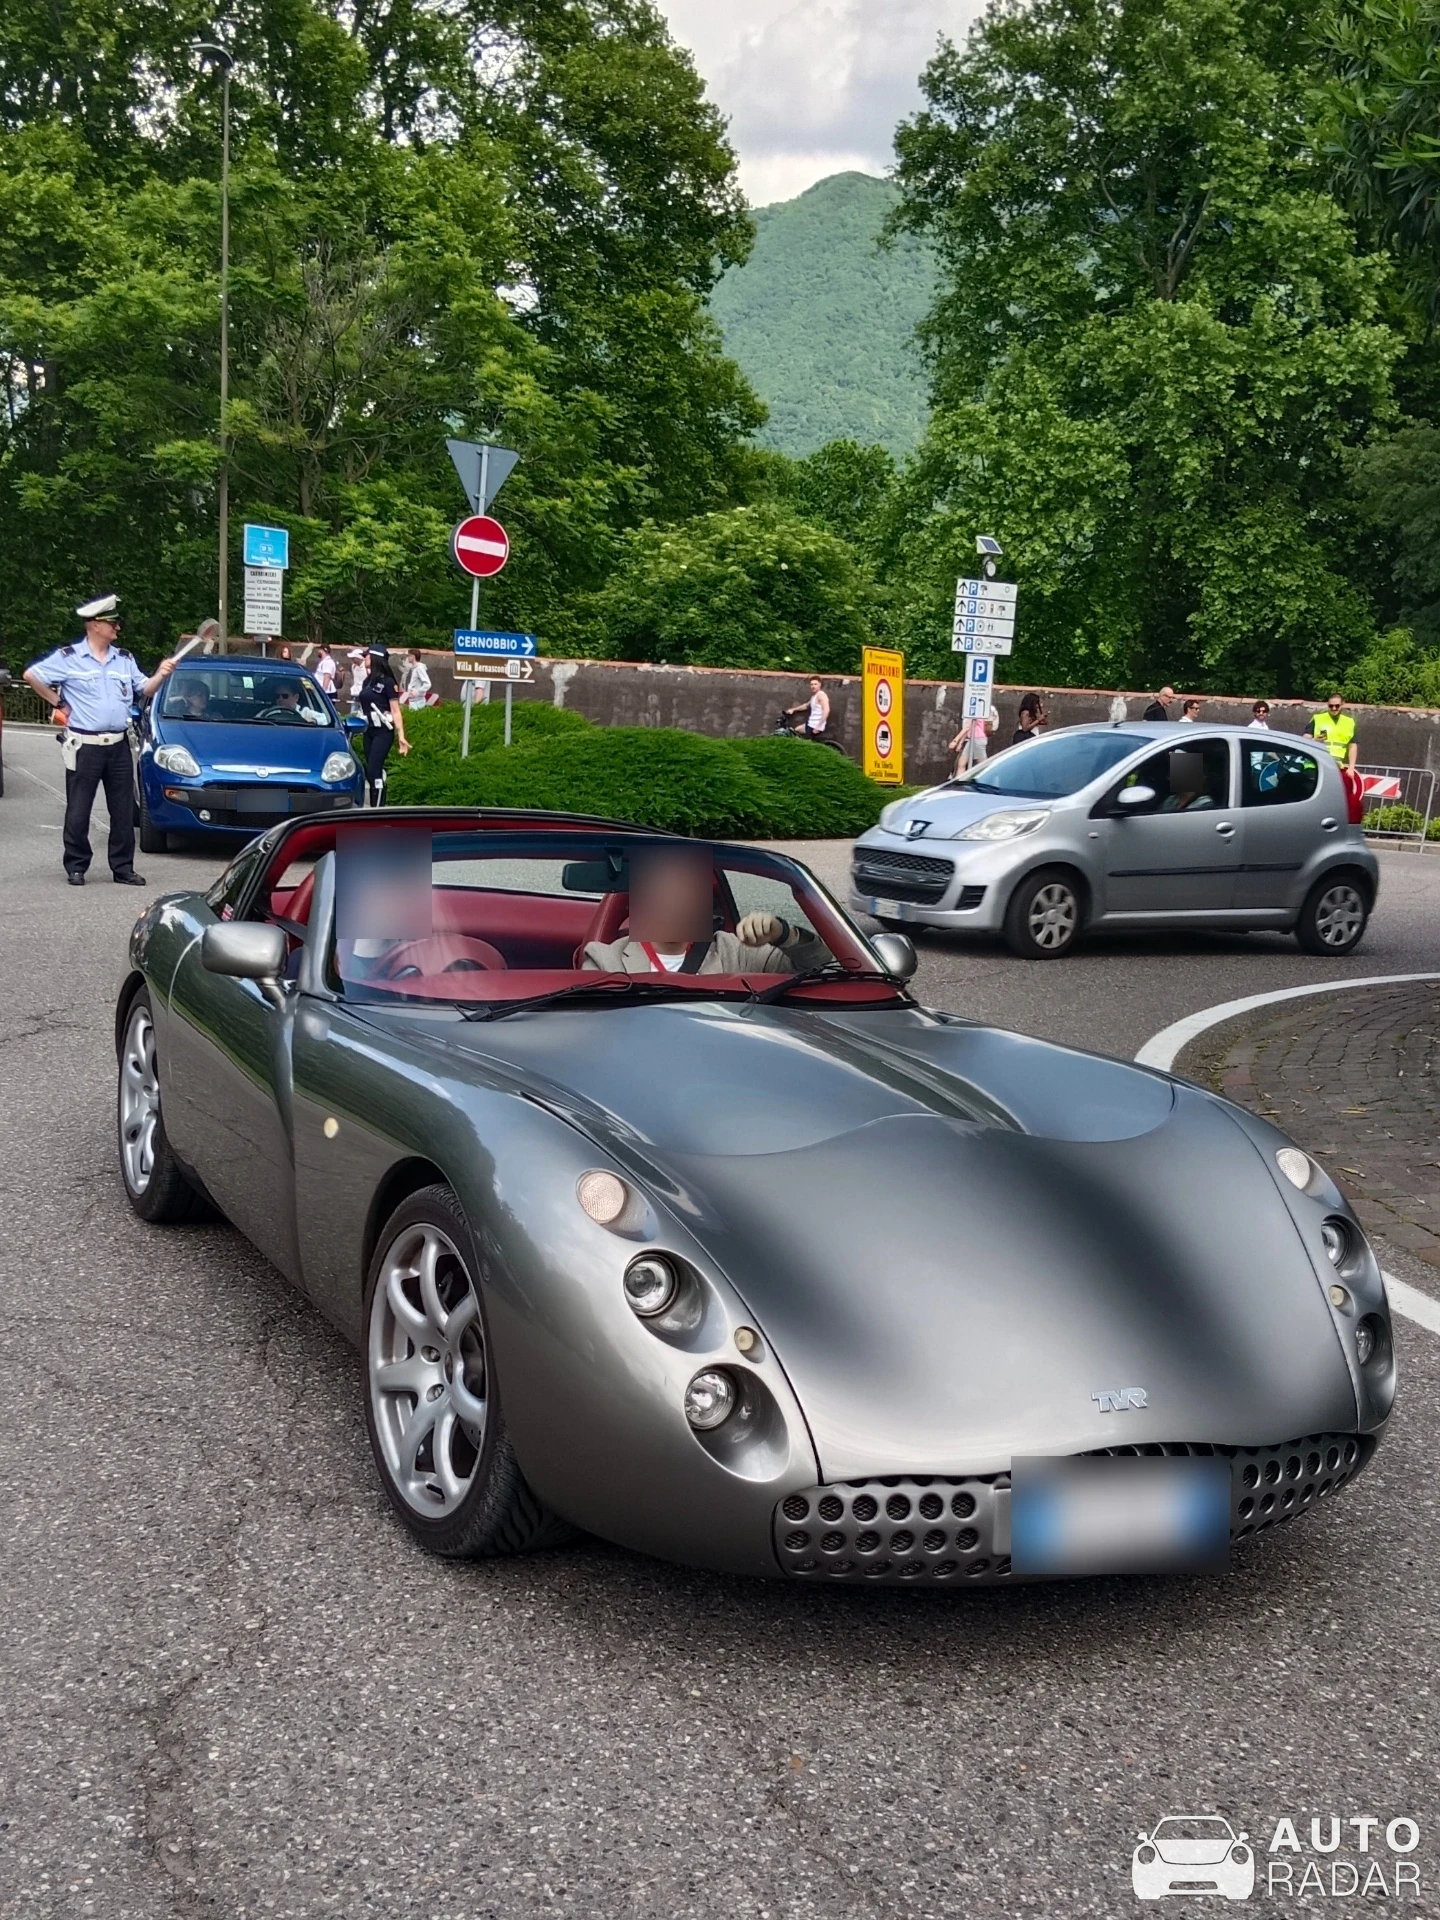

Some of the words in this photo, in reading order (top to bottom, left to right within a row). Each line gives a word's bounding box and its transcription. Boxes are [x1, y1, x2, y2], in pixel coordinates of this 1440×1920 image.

[457, 635, 518, 650] CERNOBBIO
[456, 661, 472, 672] Villa
[974, 661, 986, 681] P
[1091, 1387, 1147, 1413] TVR
